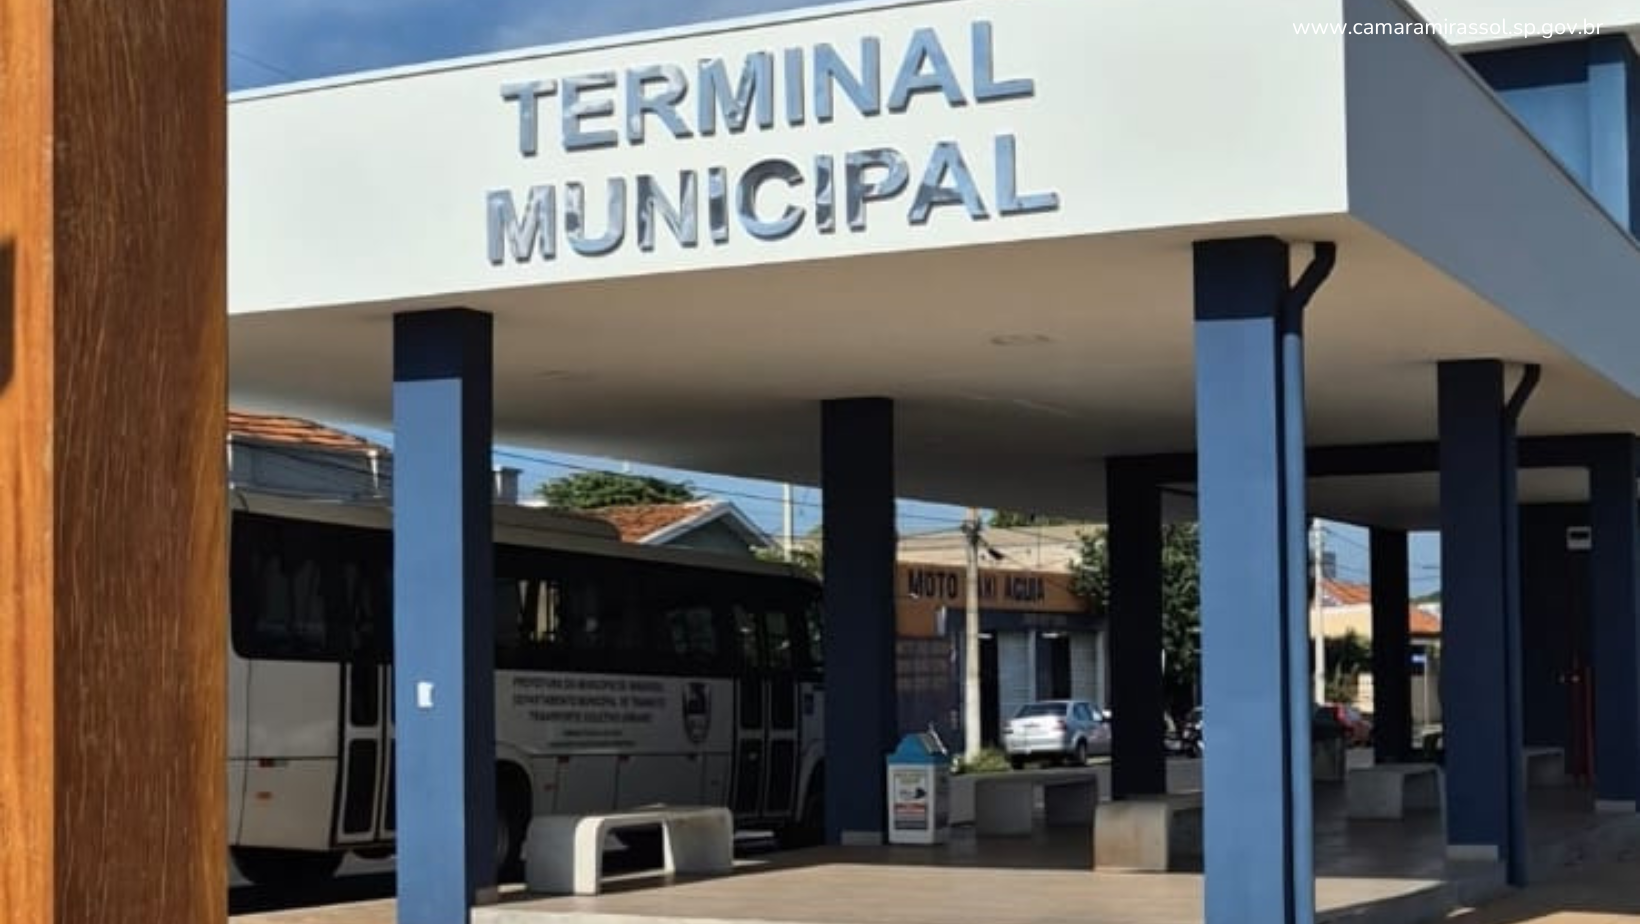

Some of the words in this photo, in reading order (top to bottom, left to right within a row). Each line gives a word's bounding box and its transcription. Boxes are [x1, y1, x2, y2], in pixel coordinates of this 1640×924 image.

[502, 21, 1034, 157] TERMINAL
[488, 134, 1059, 266] MUNICIPAL
[908, 567, 958, 599] MOTO
